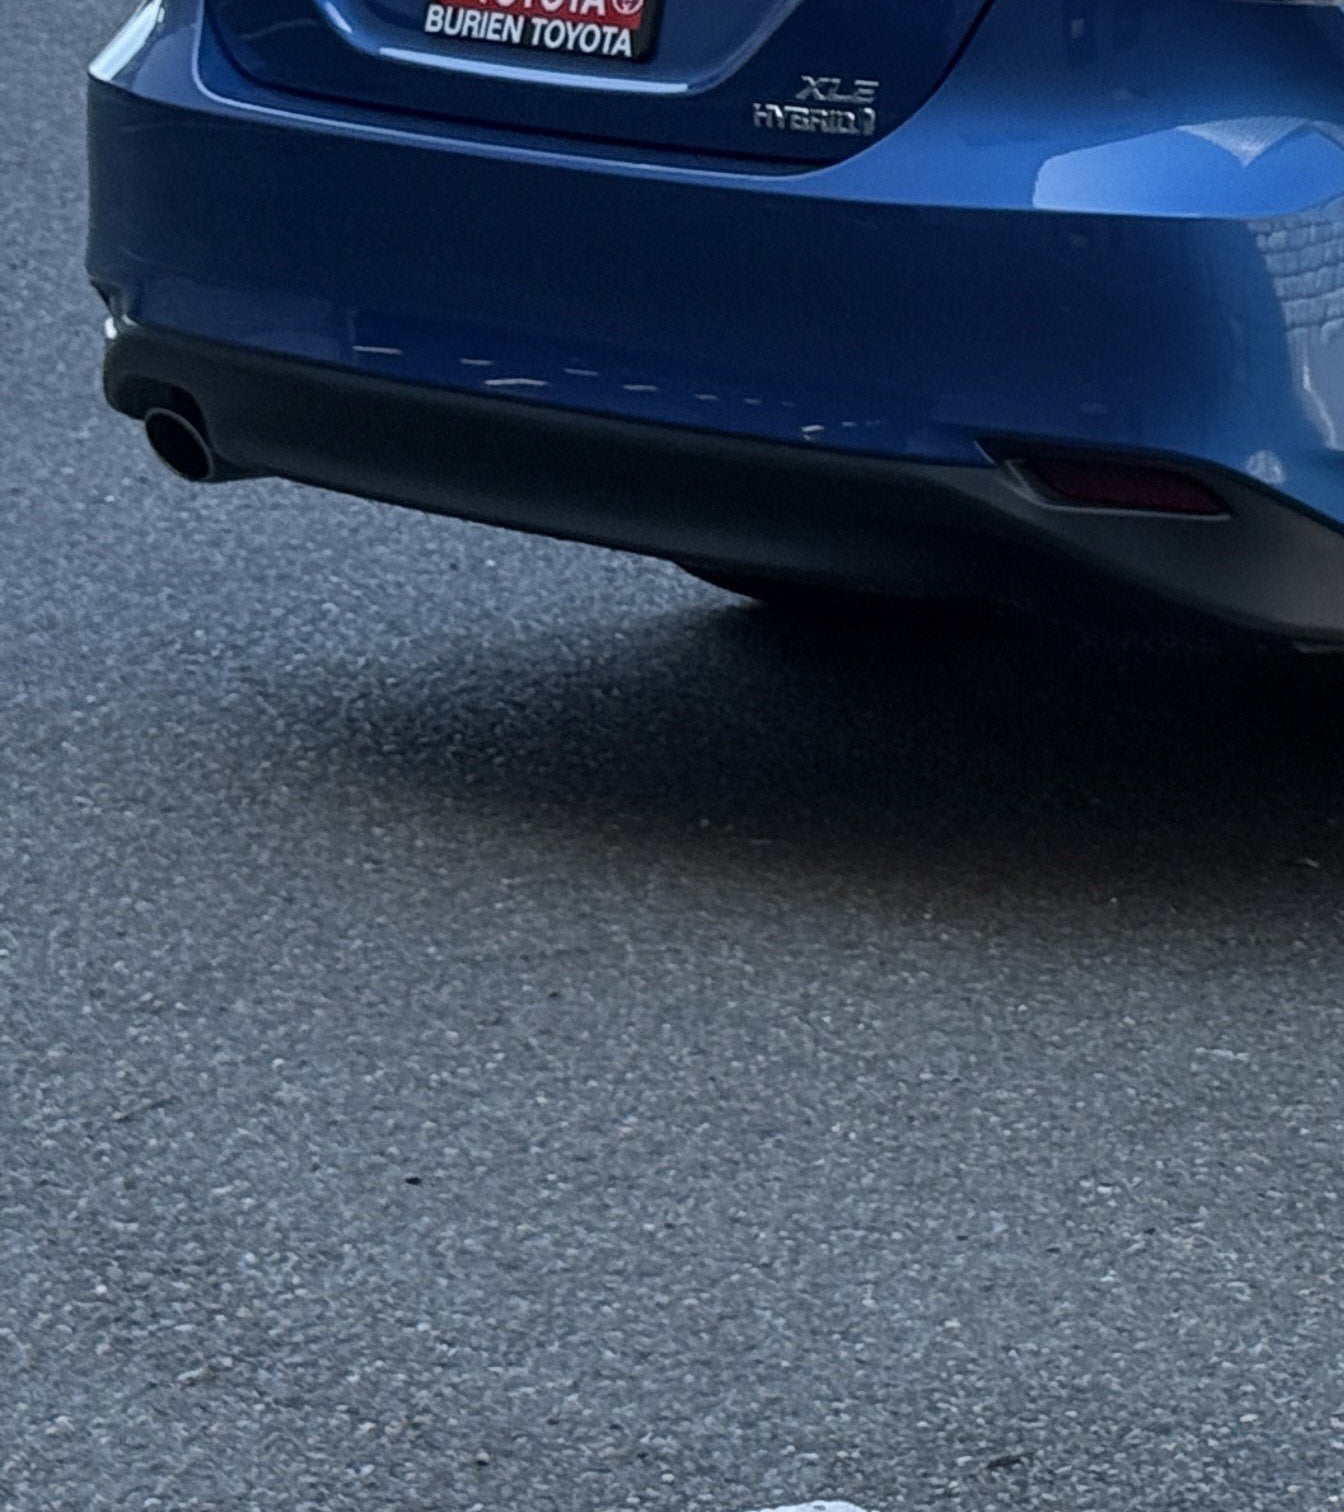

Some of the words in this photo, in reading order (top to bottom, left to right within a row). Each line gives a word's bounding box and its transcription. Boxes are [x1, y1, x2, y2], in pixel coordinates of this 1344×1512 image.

[424, 4, 525, 45] BURIEN
[531, 17, 633, 58] TOYOTA
[795, 75, 880, 104] XLE
[753, 103, 875, 136] HYBRID
